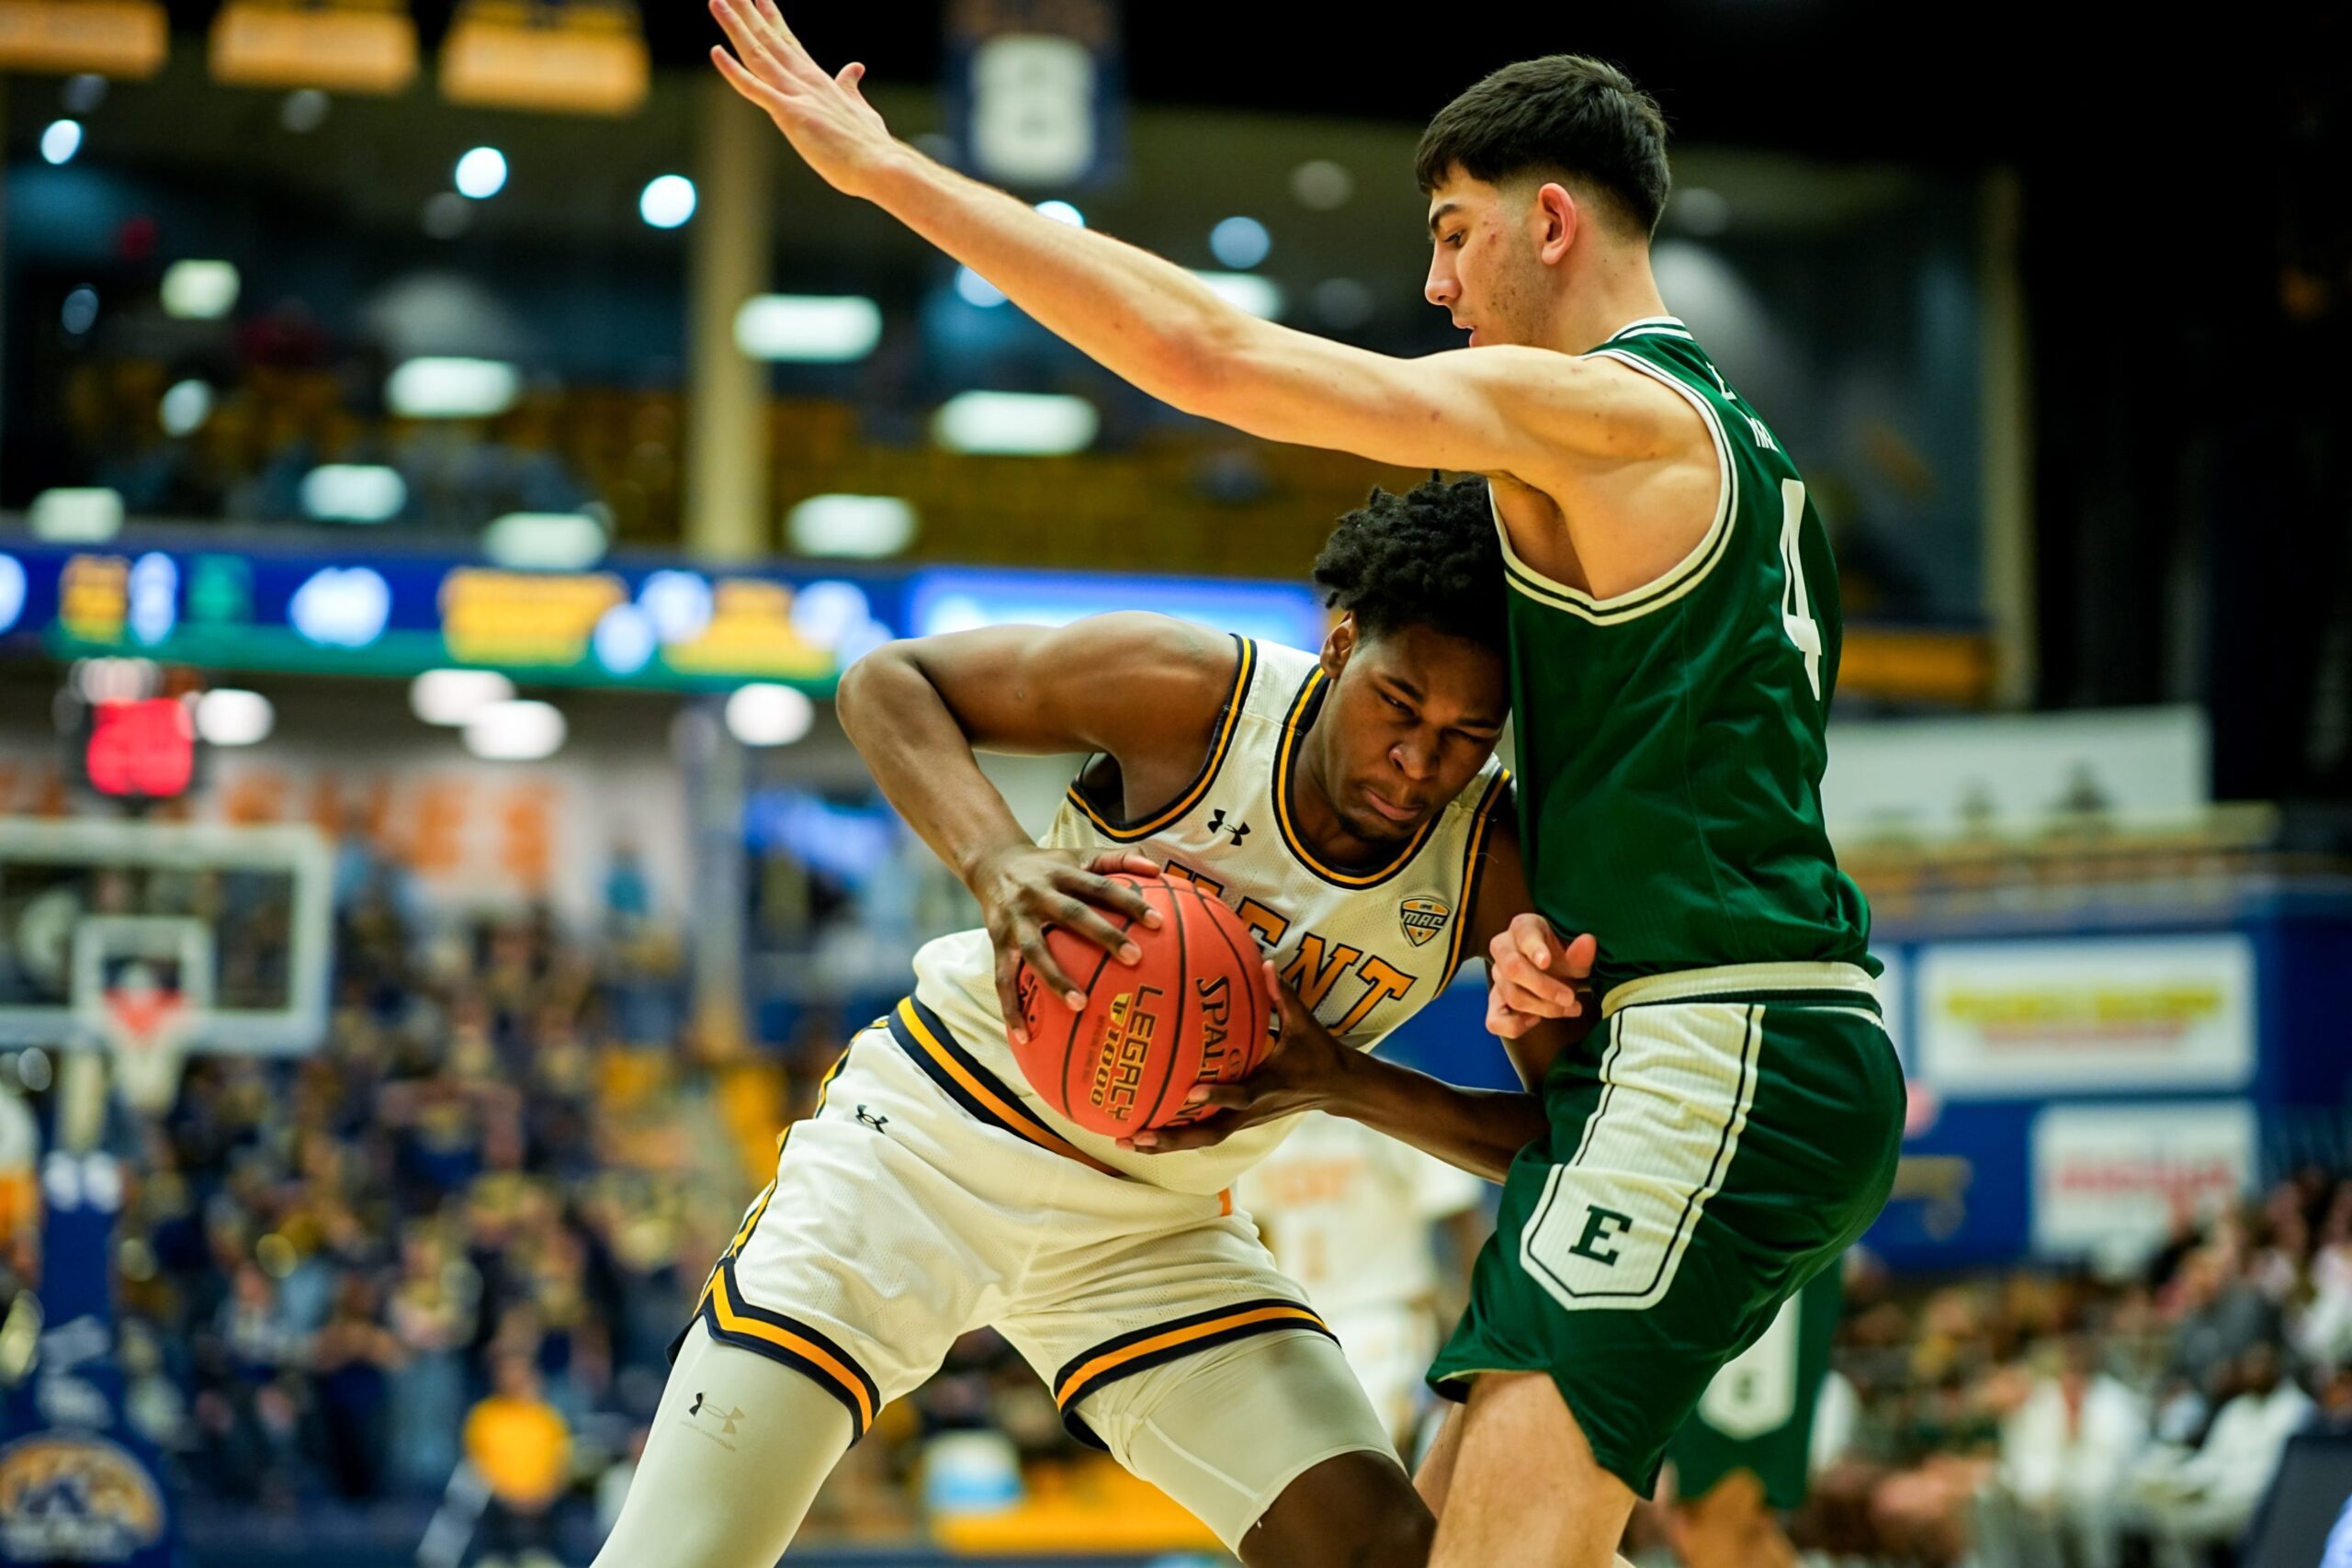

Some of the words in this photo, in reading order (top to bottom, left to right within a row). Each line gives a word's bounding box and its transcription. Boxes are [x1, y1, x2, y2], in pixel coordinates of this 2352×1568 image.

[1780, 478, 1822, 702] 4
[1163, 859, 1418, 1058] ENT
[1403, 910, 1447, 929] MAC
[1106, 984, 1164, 1122] LEGACY
[1568, 1204, 1634, 1267] E
